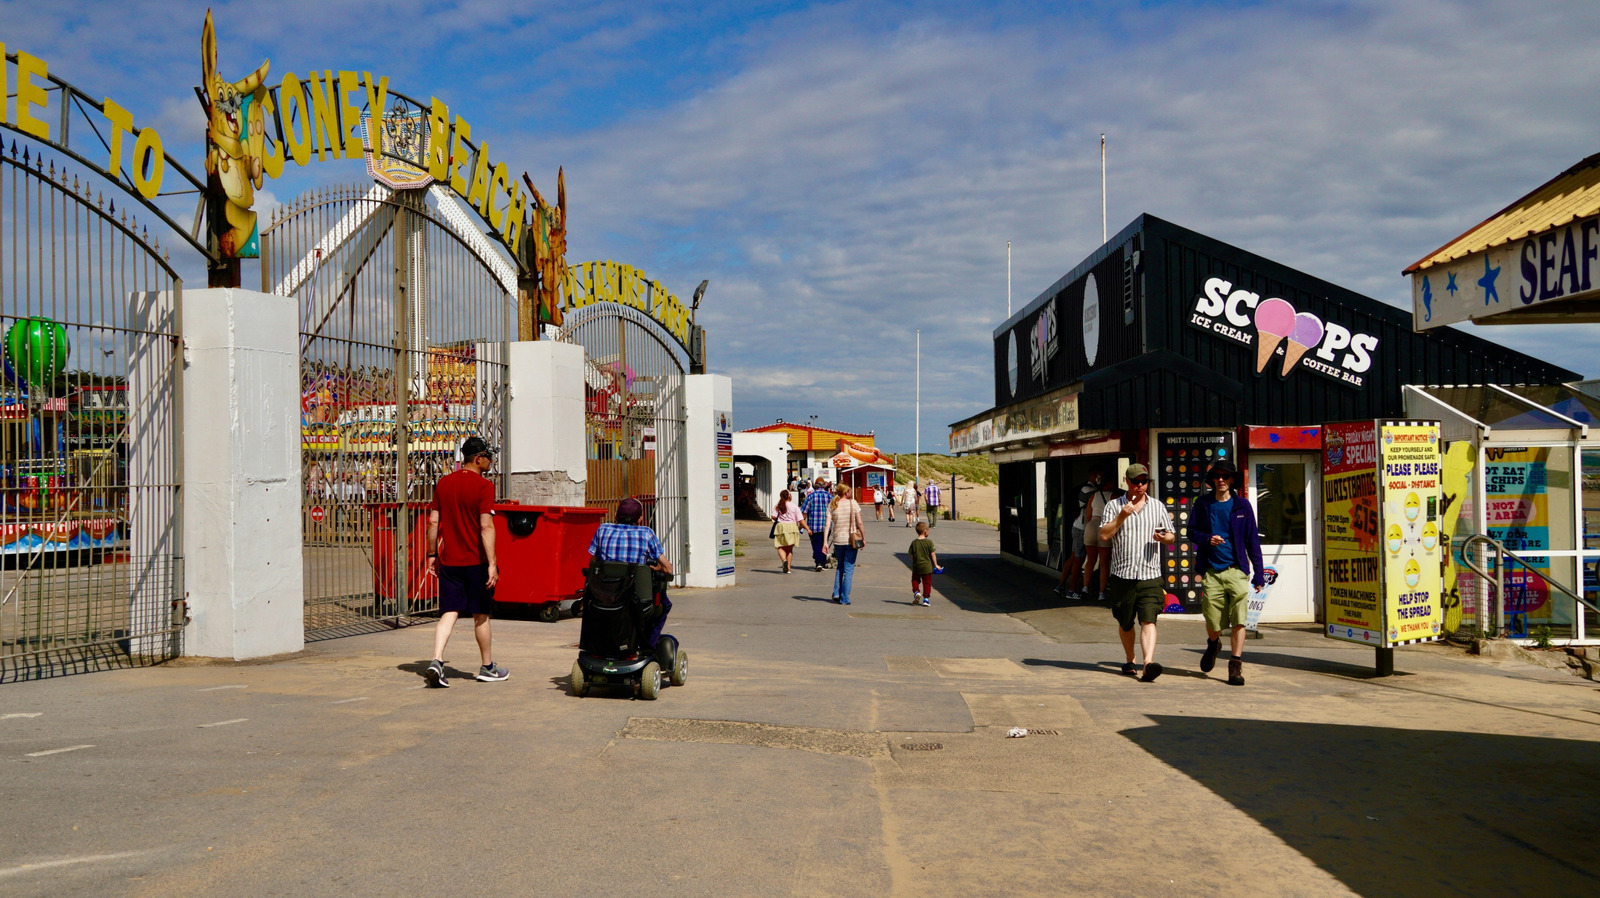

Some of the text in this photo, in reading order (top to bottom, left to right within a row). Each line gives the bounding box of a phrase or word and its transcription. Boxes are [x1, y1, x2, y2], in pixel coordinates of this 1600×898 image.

[0, 42, 164, 199] E TO
[262, 70, 527, 255] CONEY BEACH
[561, 259, 690, 346] PLEASURE PARK
[1191, 314, 1363, 386] ICE CREAM & COFFEE BAR
[1345, 430, 1375, 443] FRIDAY NIGHT
[1346, 444, 1376, 464] SPECIAL
[1386, 463, 1438, 476] PLEASE PLEASE
[1486, 467, 1525, 475] OT EAT
[1388, 481, 1407, 490] SOCIAL
[1411, 480, 1436, 488] DISTANCE
[1491, 476, 1524, 484] CHIPS
[1325, 472, 1376, 503] WRISTBANDS
[1486, 484, 1505, 492] ERE
[1492, 501, 1526, 510] NOT A
[1326, 515, 1339, 523] FROM
[1354, 504, 1377, 537] £15
[1495, 511, 1527, 520] AREA
[1328, 557, 1378, 583] FREE ENTRY
[1330, 587, 1376, 602] TOKEN MACHINES
[1398, 591, 1429, 606] HELP STOP
[1330, 598, 1377, 611] AVAILABLE THROUGHOUT
[1344, 609, 1352, 617] THE
[1397, 605, 1432, 620] THE SPREAD
[1407, 623, 1420, 631] THANK
[1420, 622, 1429, 630] YOU
